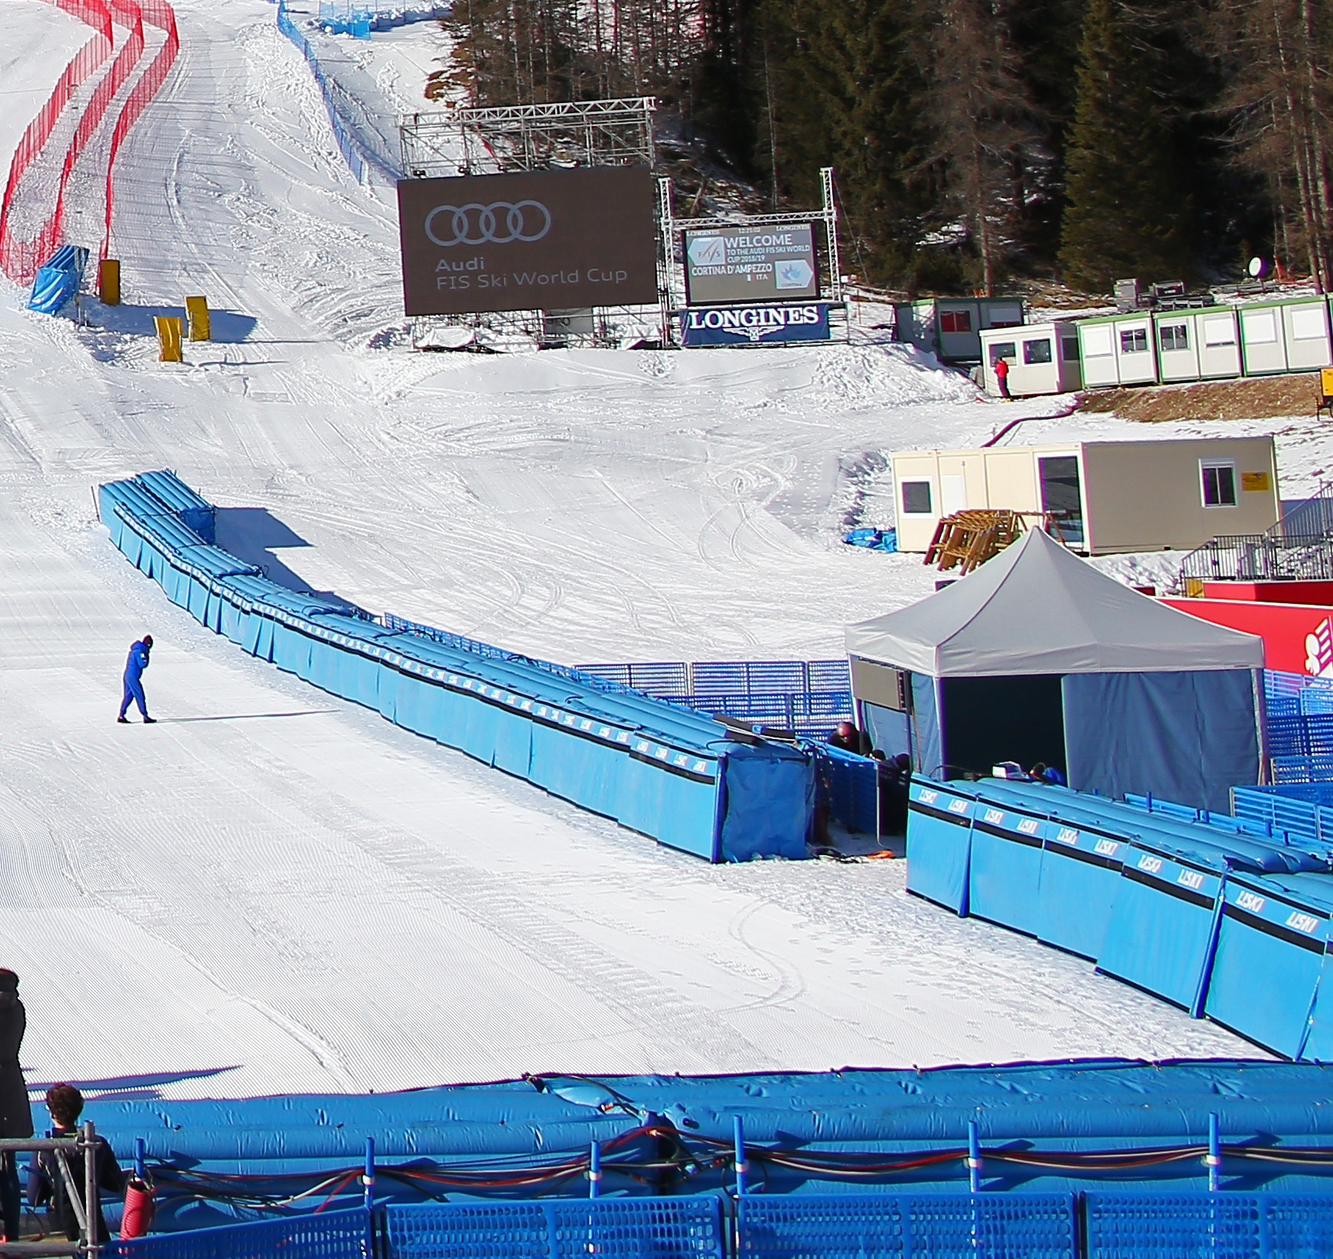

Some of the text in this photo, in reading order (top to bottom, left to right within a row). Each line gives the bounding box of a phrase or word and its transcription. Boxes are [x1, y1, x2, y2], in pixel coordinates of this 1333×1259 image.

[725, 234, 792, 248] WELCOME
[749, 247, 765, 255] AUDI
[766, 246, 775, 254] FIS
[787, 245, 810, 253] WORLD
[435, 257, 484, 272] Audi
[691, 263, 772, 276] CORTINA D'AMPEZZO
[437, 268, 627, 290] FIS Ski World Cup
[689, 306, 819, 329] LONGINES
[1137, 854, 1162, 873] LISKI
[1177, 869, 1203, 889] LISKI
[1236, 891, 1265, 912] LISKI
[1286, 911, 1318, 933] LISKI
